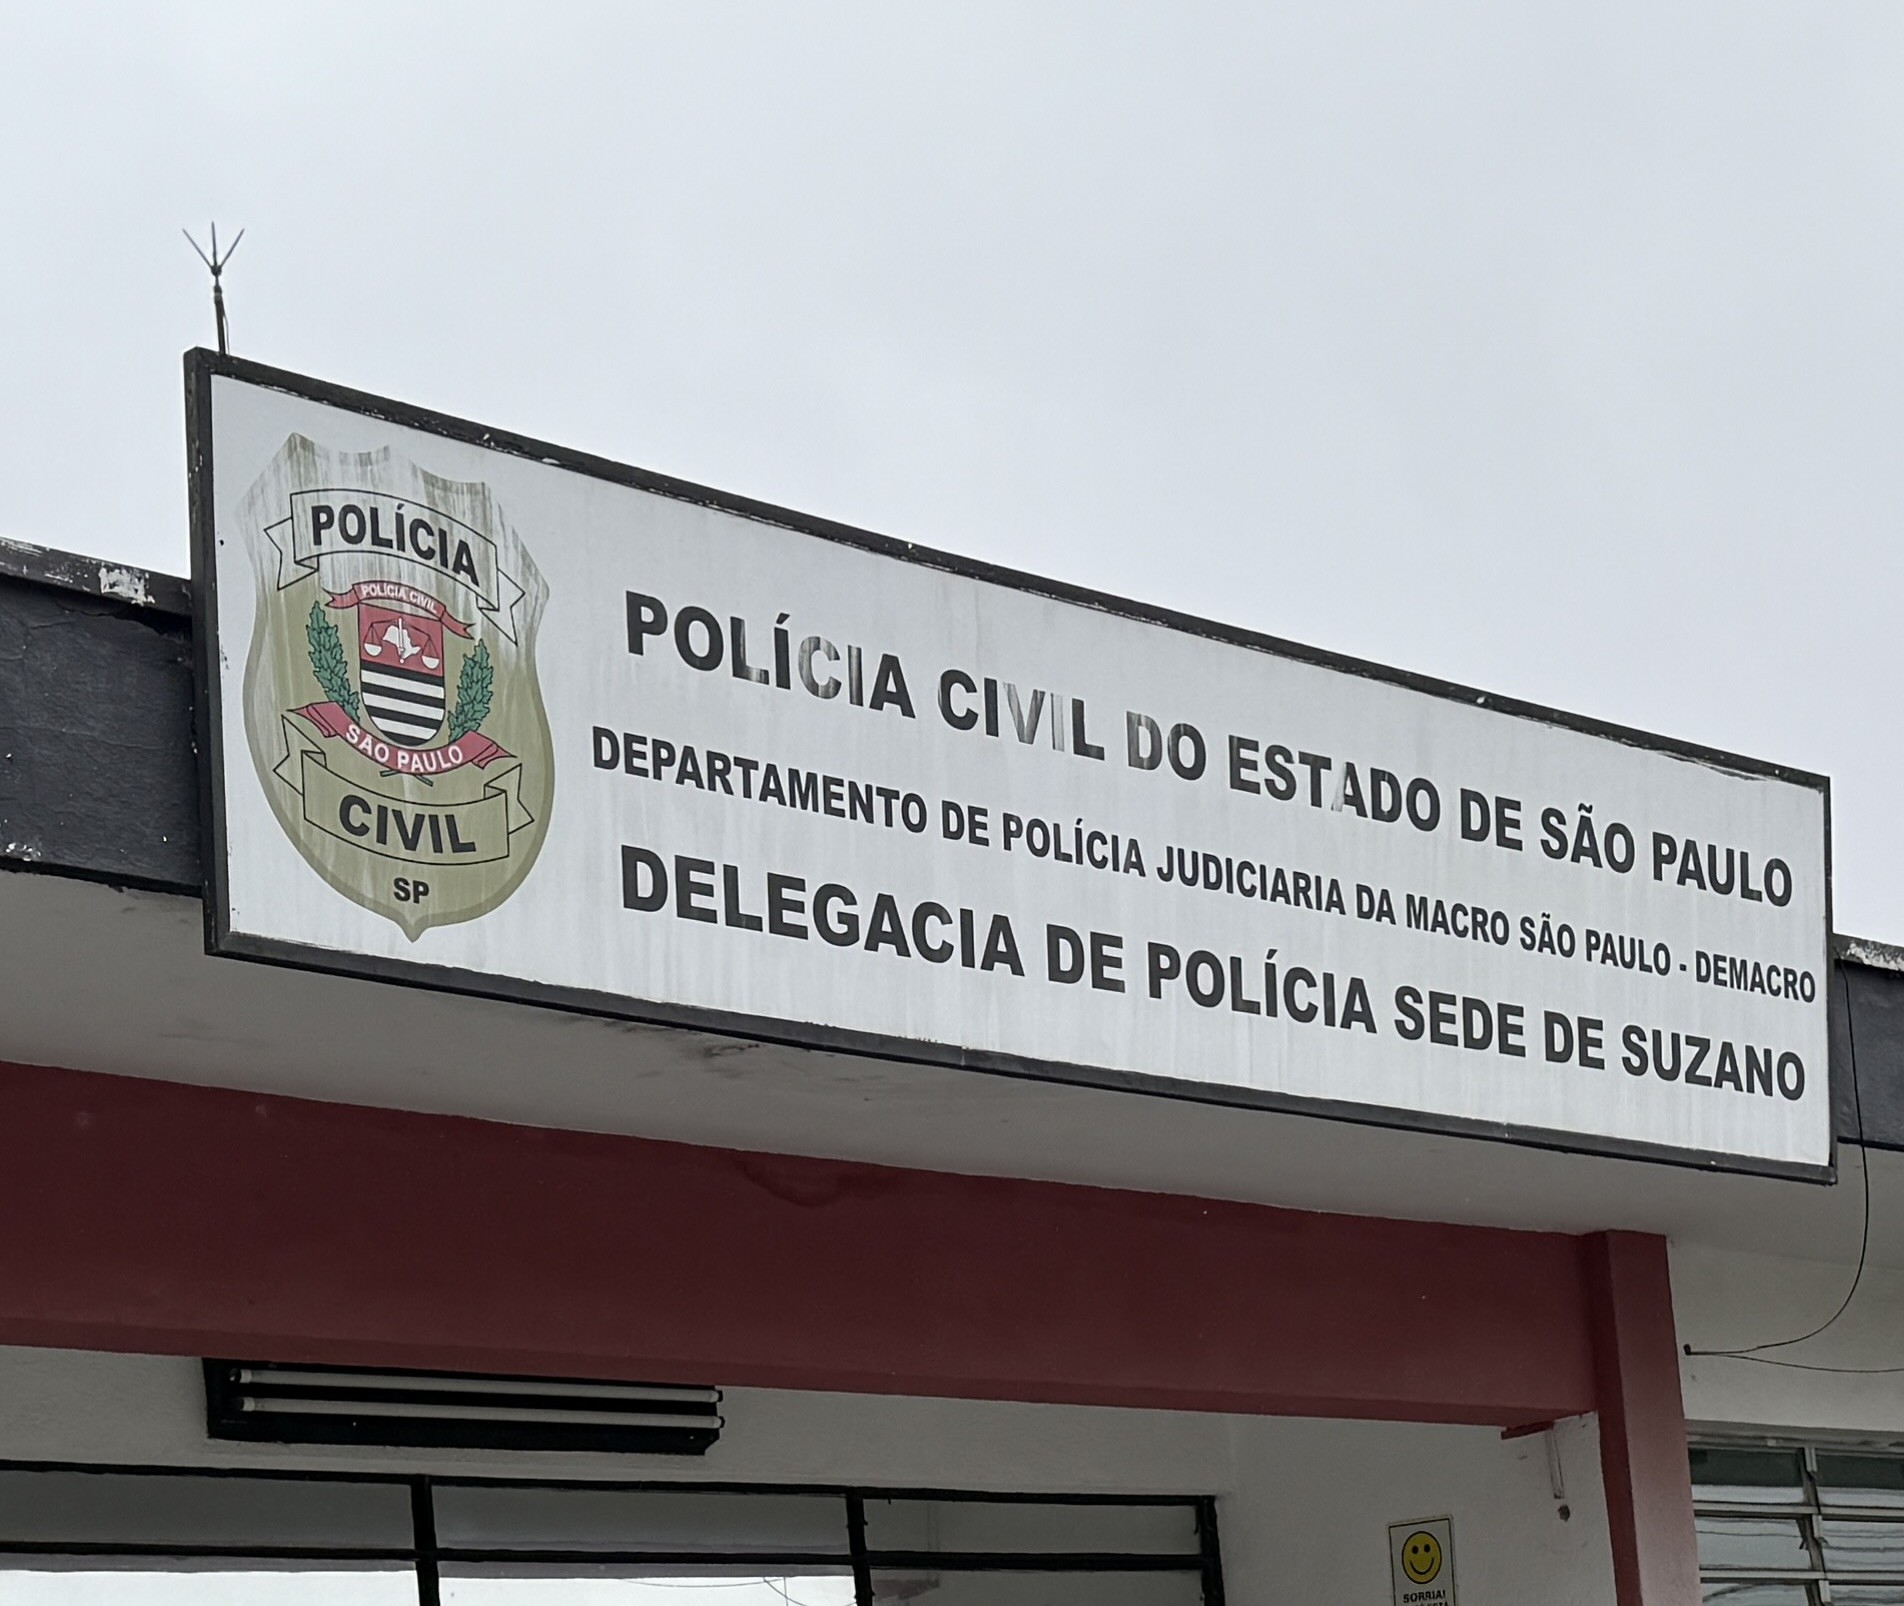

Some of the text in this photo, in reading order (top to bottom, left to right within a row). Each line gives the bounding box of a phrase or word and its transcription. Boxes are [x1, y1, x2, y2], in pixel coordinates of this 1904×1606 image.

[311, 503, 480, 587] POLÍCIA
[409, 591, 437, 613] CIVIL
[397, 745, 463, 772] PAULO
[626, 591, 1793, 907] POLÍCIA CIVIL DO ESTADO DE SÃO PAULO
[339, 794, 476, 853] CIVIL
[393, 877, 429, 904] SP
[593, 726, 927, 833] DEPARTAMENTO
[941, 800, 989, 847] DE
[1002, 819, 1146, 878] POLÍCIA
[1156, 845, 1346, 915] JUDICIARIA
[1356, 884, 1396, 925] DA
[1406, 893, 1509, 945] MACRO
[1520, 912, 1576, 958] SÃO
[1586, 928, 1671, 976] PAULO
[1695, 950, 1816, 1003] DEMACRO
[621, 844, 1805, 1101] DELEGACIA DE POLÍCIA SEDE DE SUZANO
